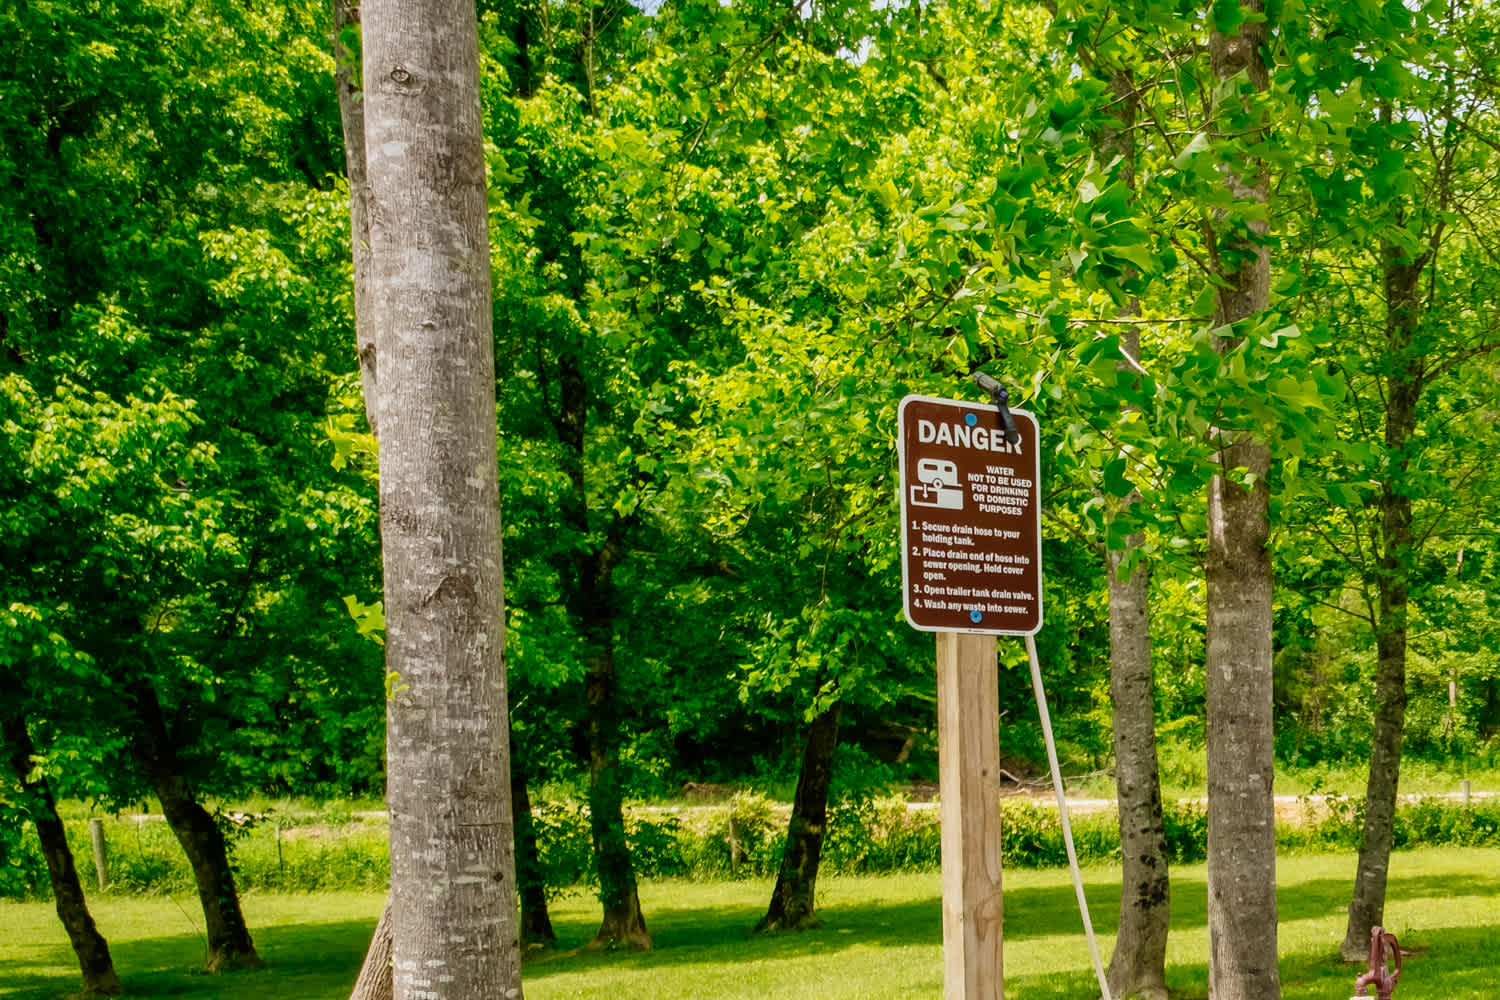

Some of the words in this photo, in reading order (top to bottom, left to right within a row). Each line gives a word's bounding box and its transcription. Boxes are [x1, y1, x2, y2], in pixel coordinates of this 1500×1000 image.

[986, 465, 1015, 476] WATER
[967, 473, 985, 483] NOT
[985, 475, 997, 484] TO
[997, 476, 1009, 486] BE
[1010, 477, 1032, 488] USED
[971, 483, 989, 493] FOR
[989, 485, 1029, 497] DRINKING
[973, 493, 985, 502] OR
[986, 494, 1028, 507] DOMESTIC
[979, 503, 1023, 516] PURPOSES
[912, 520, 920, 530] 1.
[921, 521, 951, 533] Secure
[951, 524, 973, 535] drain
[973, 526, 993, 537] hose
[994, 527, 1002, 537] to
[1003, 529, 1021, 539] your
[922, 532, 953, 546] holding
[953, 535, 975, 546] tank.
[912, 546, 921, 556] 2.
[922, 547, 946, 558] Place
[946, 549, 968, 560] drain
[968, 551, 985, 561] end
[985, 552, 994, 562] of
[994, 552, 1013, 563] hose
[1013, 554, 1030, 565] into
[923, 560, 947, 569] sewer
[983, 563, 1002, 573] Hold
[1002, 566, 1024, 575] cover
[923, 571, 947, 581] open.
[913, 583, 923, 593] 3.
[923, 584, 946, 596] Open
[946, 586, 971, 597] trailer
[971, 588, 990, 598] tank
[990, 589, 1012, 599] drain
[1012, 590, 1035, 601] valve.
[913, 598, 923, 608] 4.
[923, 599, 947, 609] Wash
[947, 602, 962, 612] any
[962, 602, 986, 612] waste
[986, 602, 1003, 613] into
[1003, 605, 1029, 615] sewer.
